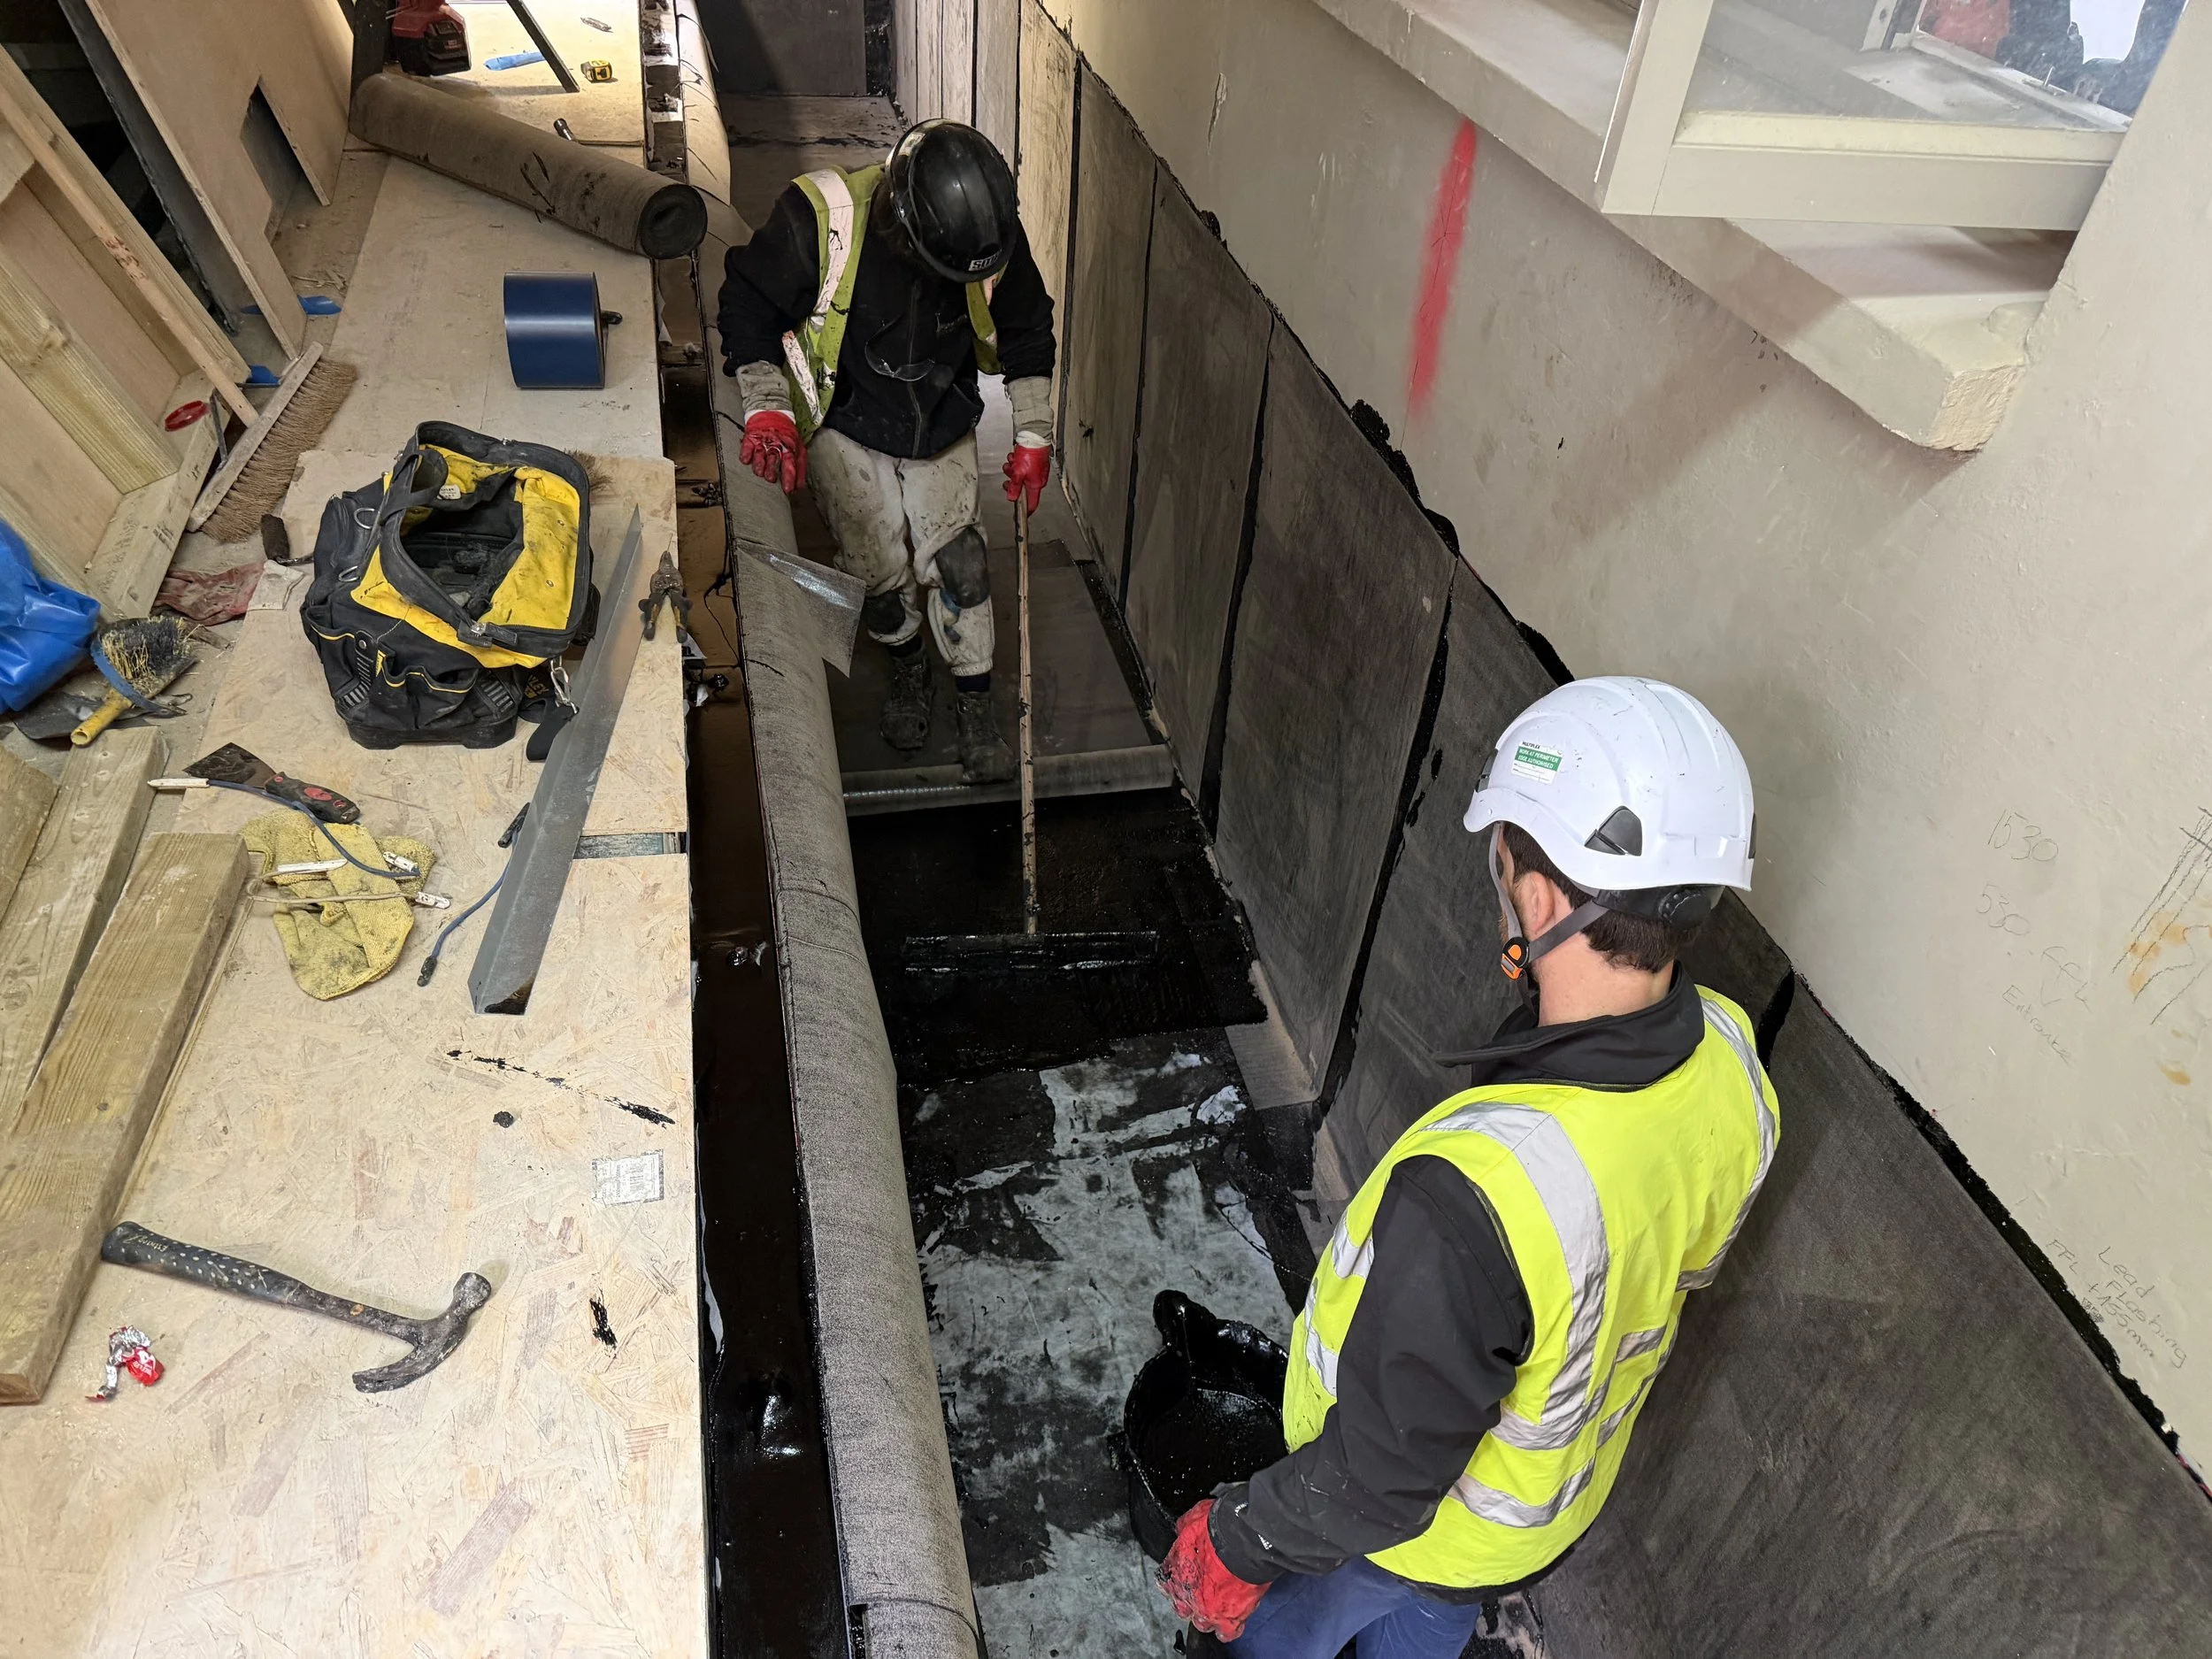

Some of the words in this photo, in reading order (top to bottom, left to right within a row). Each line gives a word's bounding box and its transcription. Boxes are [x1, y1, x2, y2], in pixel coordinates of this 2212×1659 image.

[1528, 757, 1553, 768] AUTHORISED
[1534, 752, 1558, 763] PERIMETER
[1988, 809, 2058, 861] 1530
[1976, 883, 2030, 936] 530
[2098, 1246, 2154, 1298] Lead
